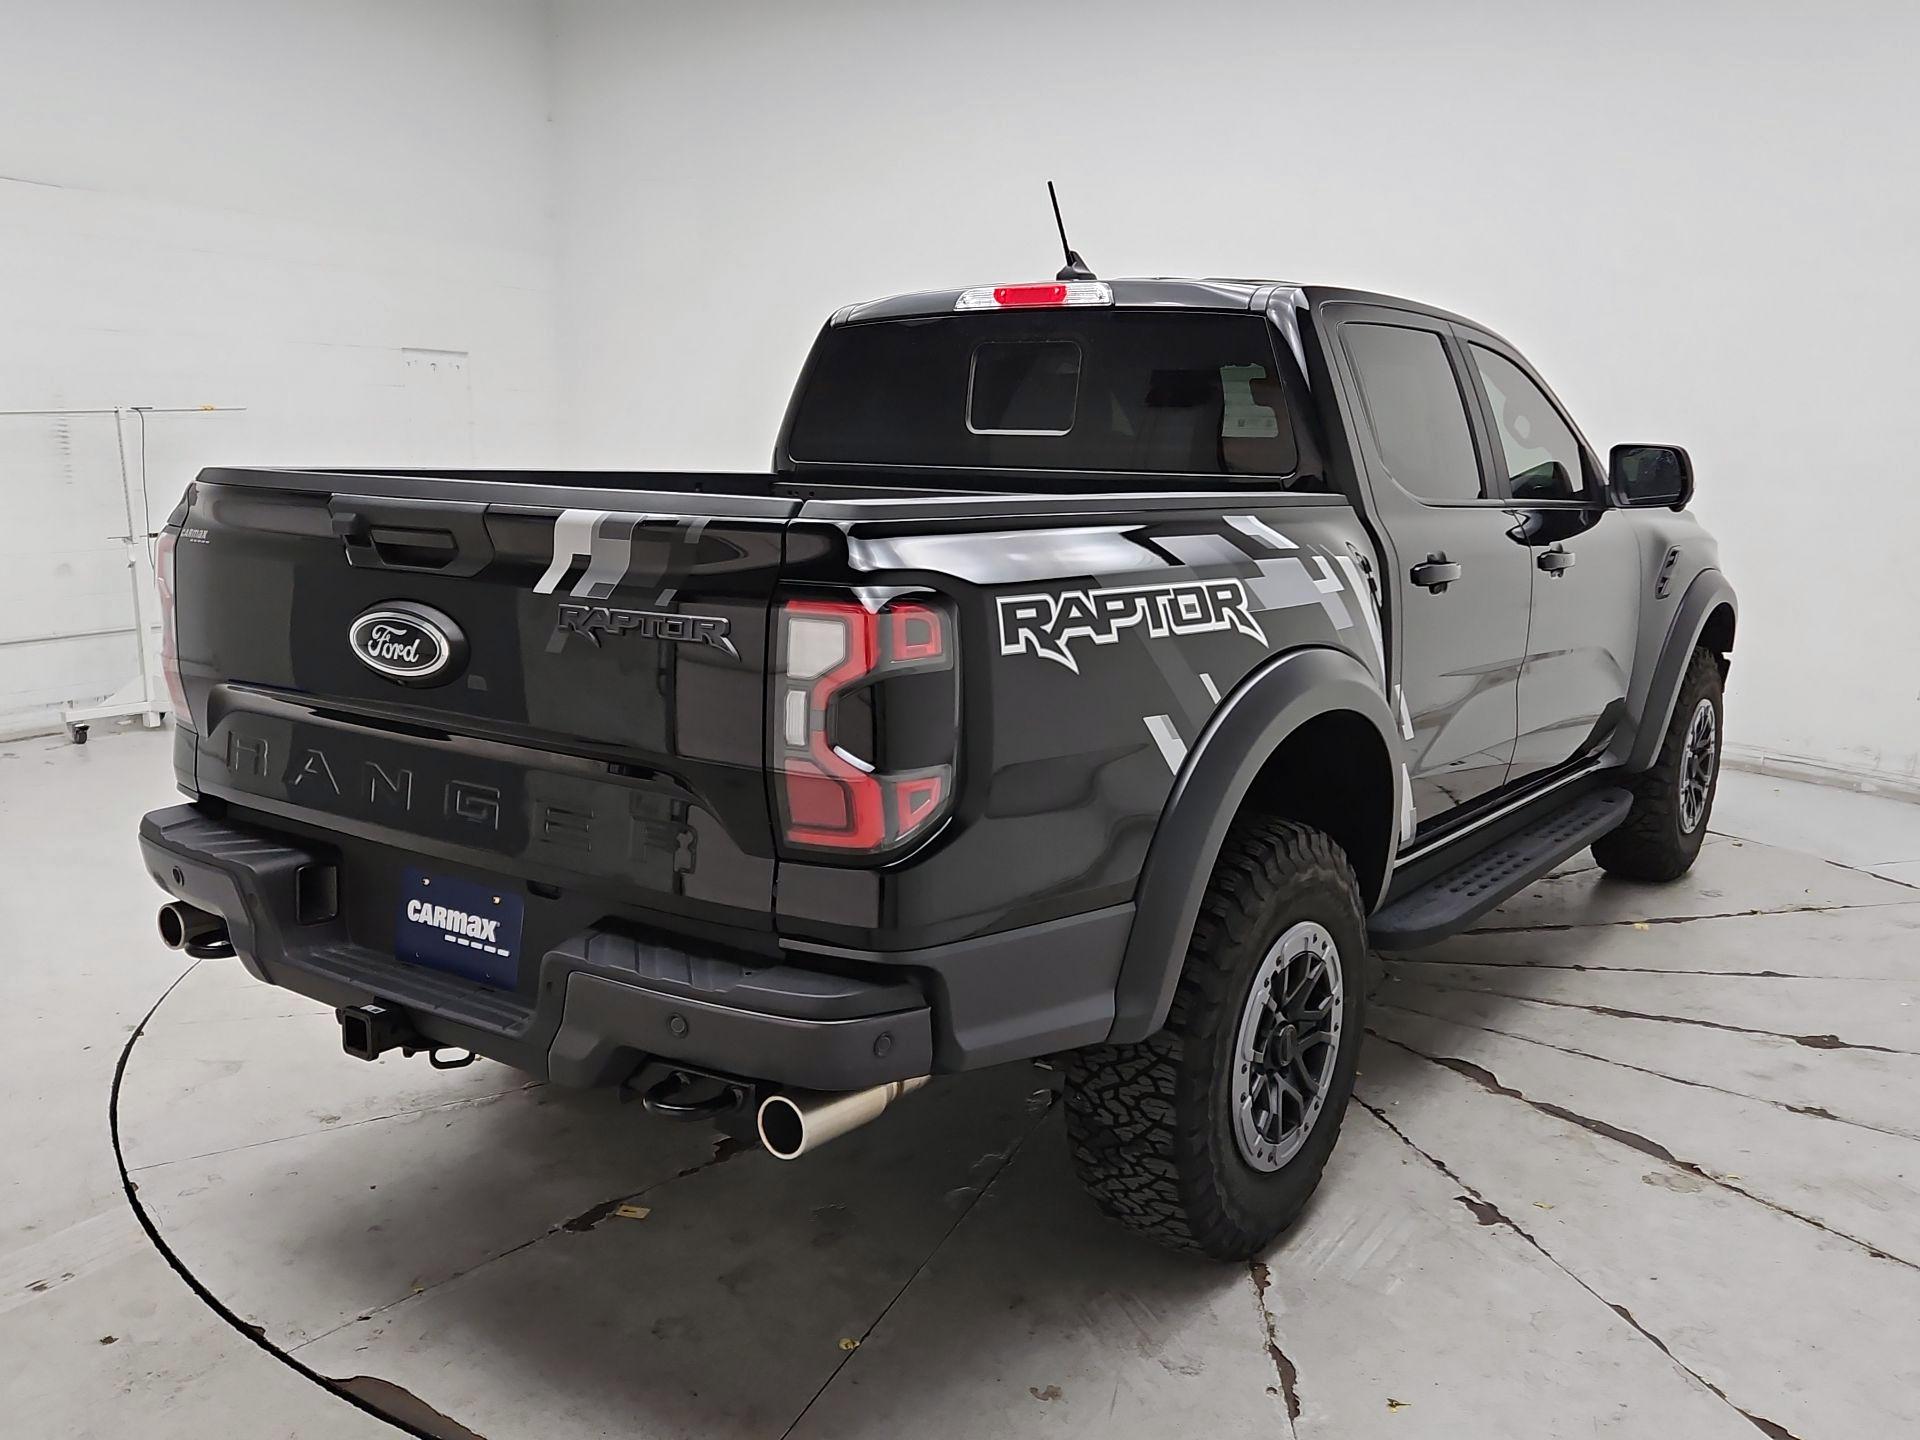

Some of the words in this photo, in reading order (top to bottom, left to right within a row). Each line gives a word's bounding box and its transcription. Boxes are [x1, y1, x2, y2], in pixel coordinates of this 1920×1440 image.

[367, 624, 420, 663] Ford
[558, 603, 741, 664] RAPTOR
[996, 577, 1270, 676] RAPTOR
